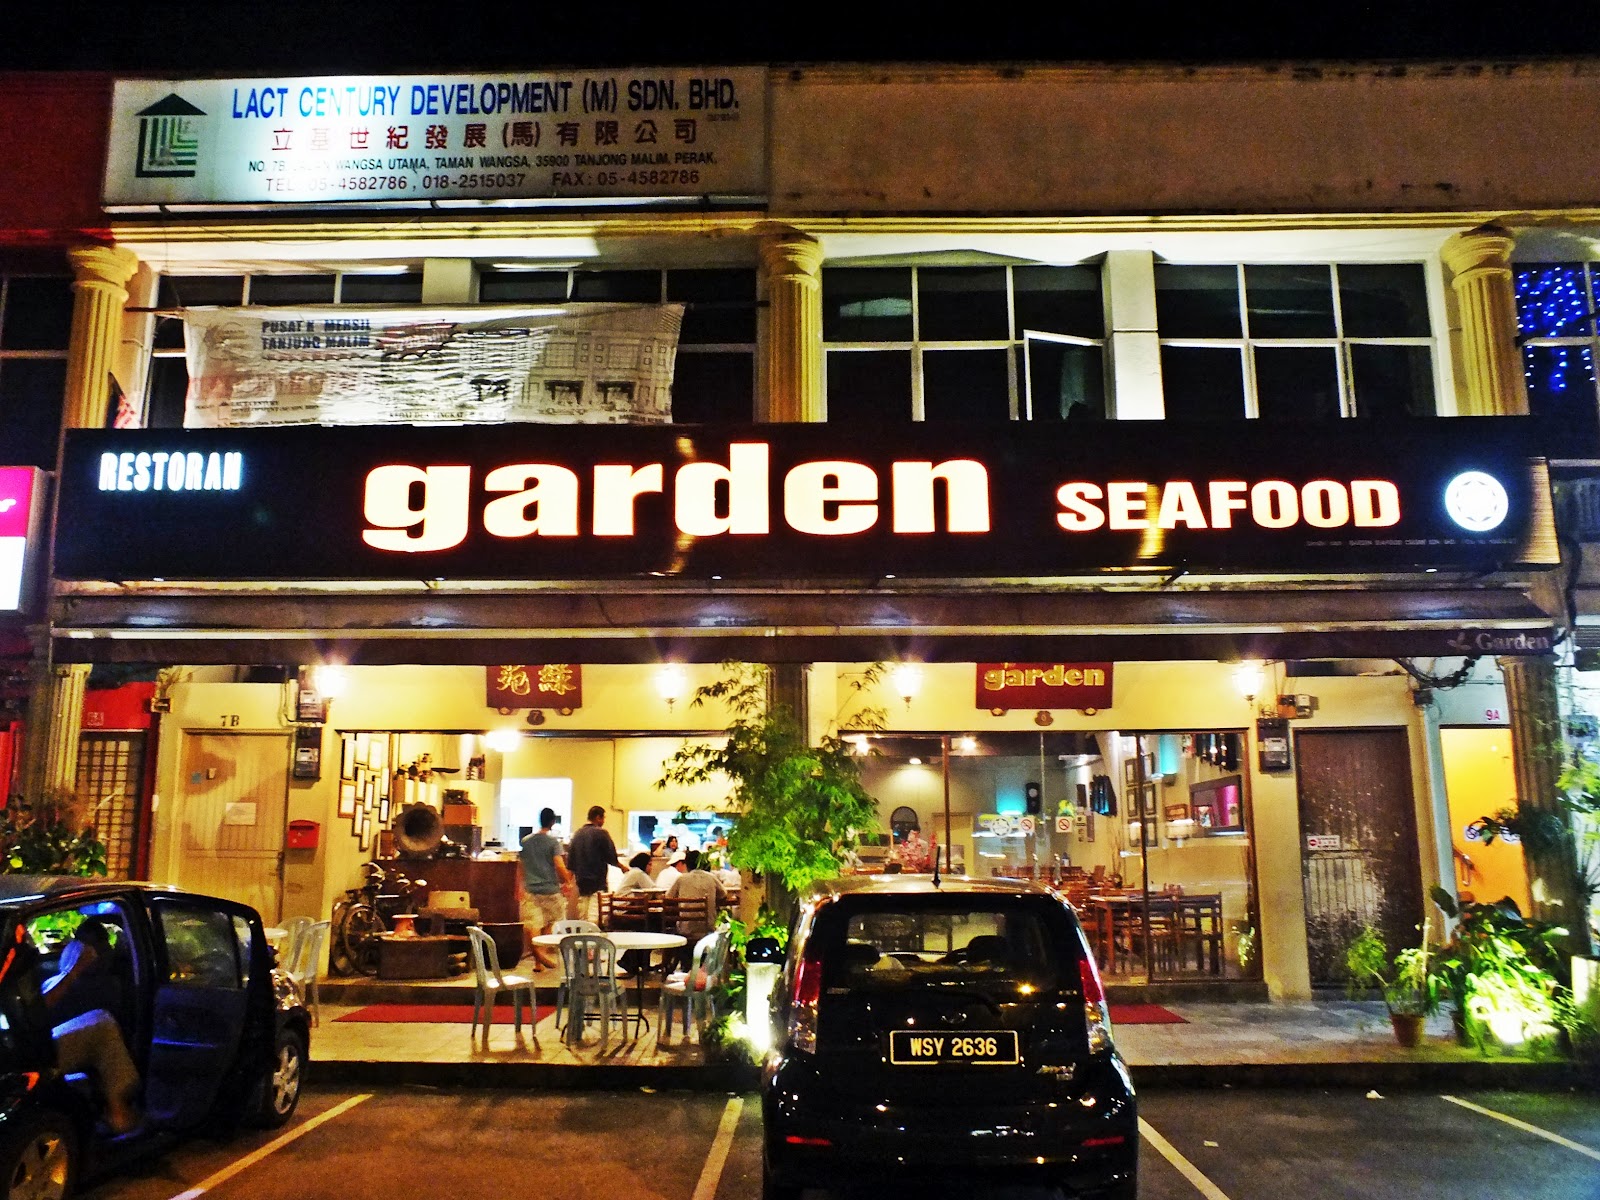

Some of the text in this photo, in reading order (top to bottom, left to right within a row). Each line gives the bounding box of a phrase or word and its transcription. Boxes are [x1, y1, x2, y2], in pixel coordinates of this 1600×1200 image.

[232, 78, 739, 118] LACT CENTURY DEVELOPMENT (M) SDN. BHD.
[335, 158, 383, 170] WANGSA
[434, 156, 474, 169] TAMAN
[574, 153, 627, 166] TANJONG
[422, 172, 526, 189] 018-2515037
[597, 169, 701, 186] 05-4582786
[98, 451, 243, 492] RESTORAN
[362, 442, 1401, 552] garden SEAFOOD
[1476, 632, 1549, 651] Garden
[984, 664, 1105, 691] garden
[1485, 709, 1500, 721] 9A
[910, 1037, 997, 1056] WSY 2636
